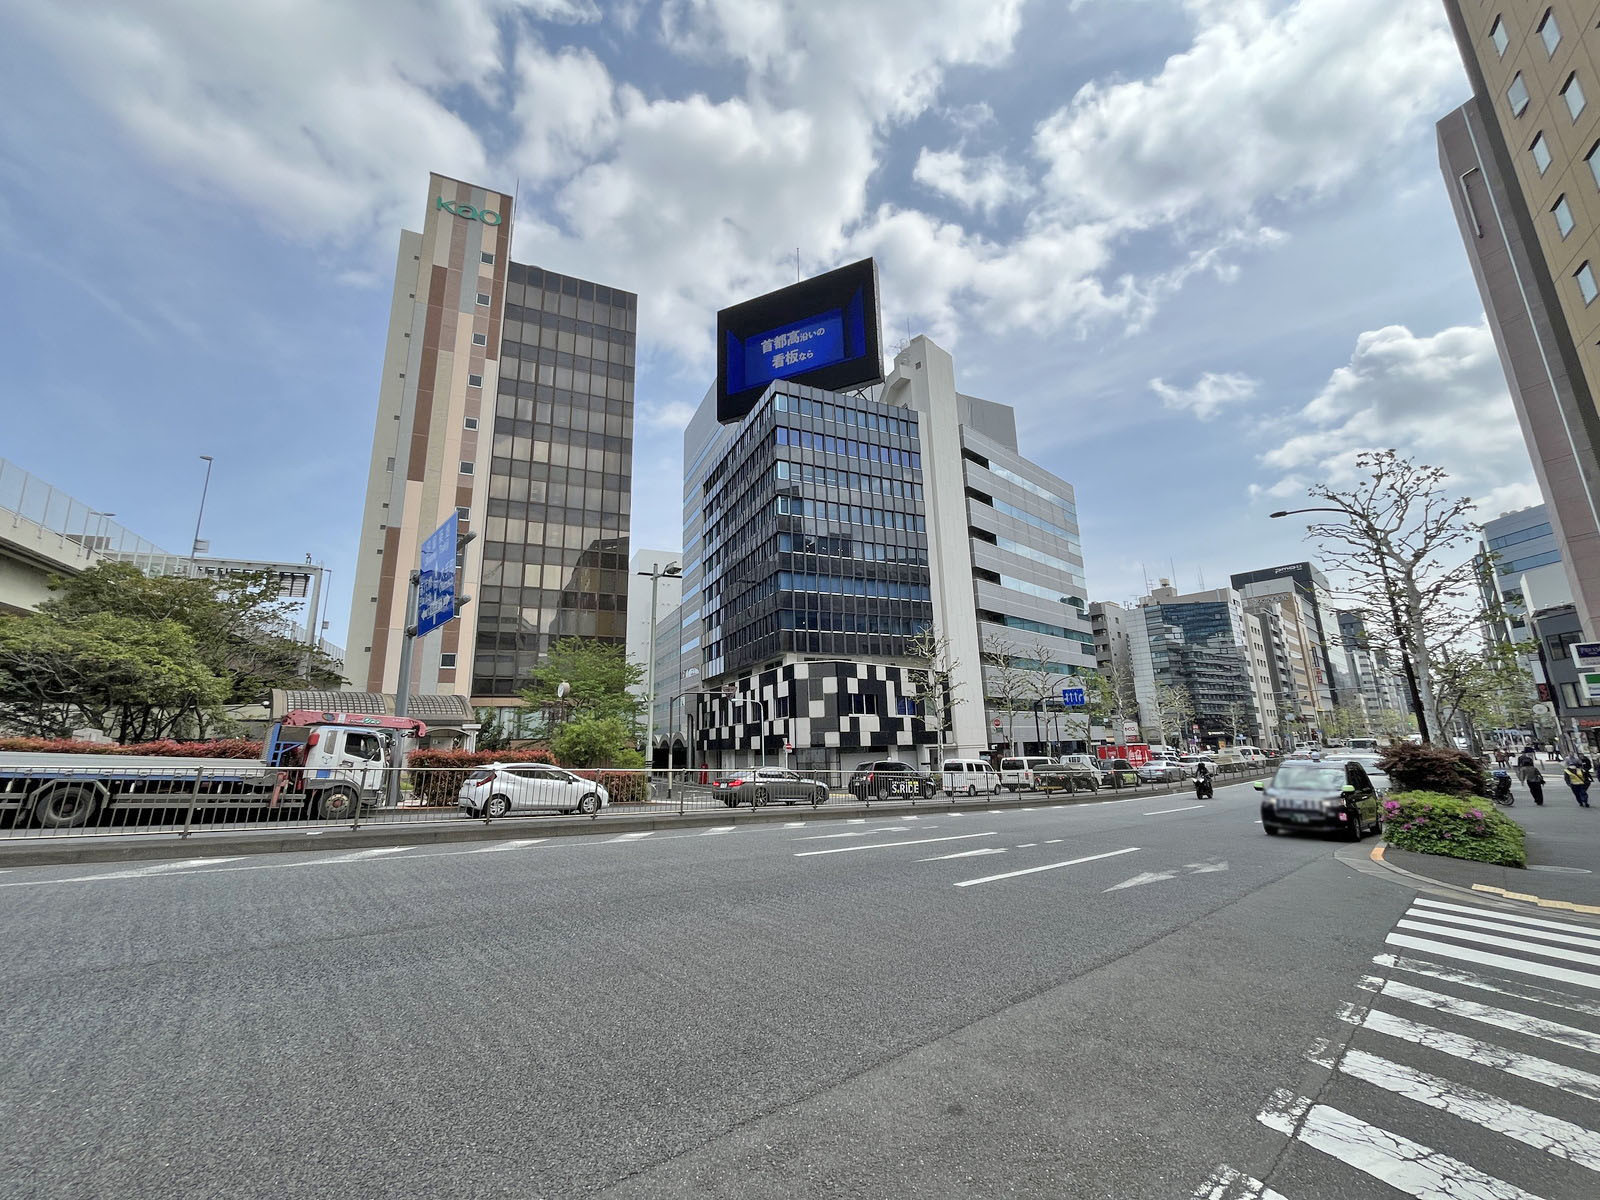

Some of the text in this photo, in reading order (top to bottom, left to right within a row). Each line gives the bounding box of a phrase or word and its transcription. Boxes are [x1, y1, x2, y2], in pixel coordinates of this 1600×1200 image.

[760, 327, 826, 354] 首都高沿いの
[771, 348, 815, 369] 看板なら
[891, 783, 919, 793] S.RIDE
